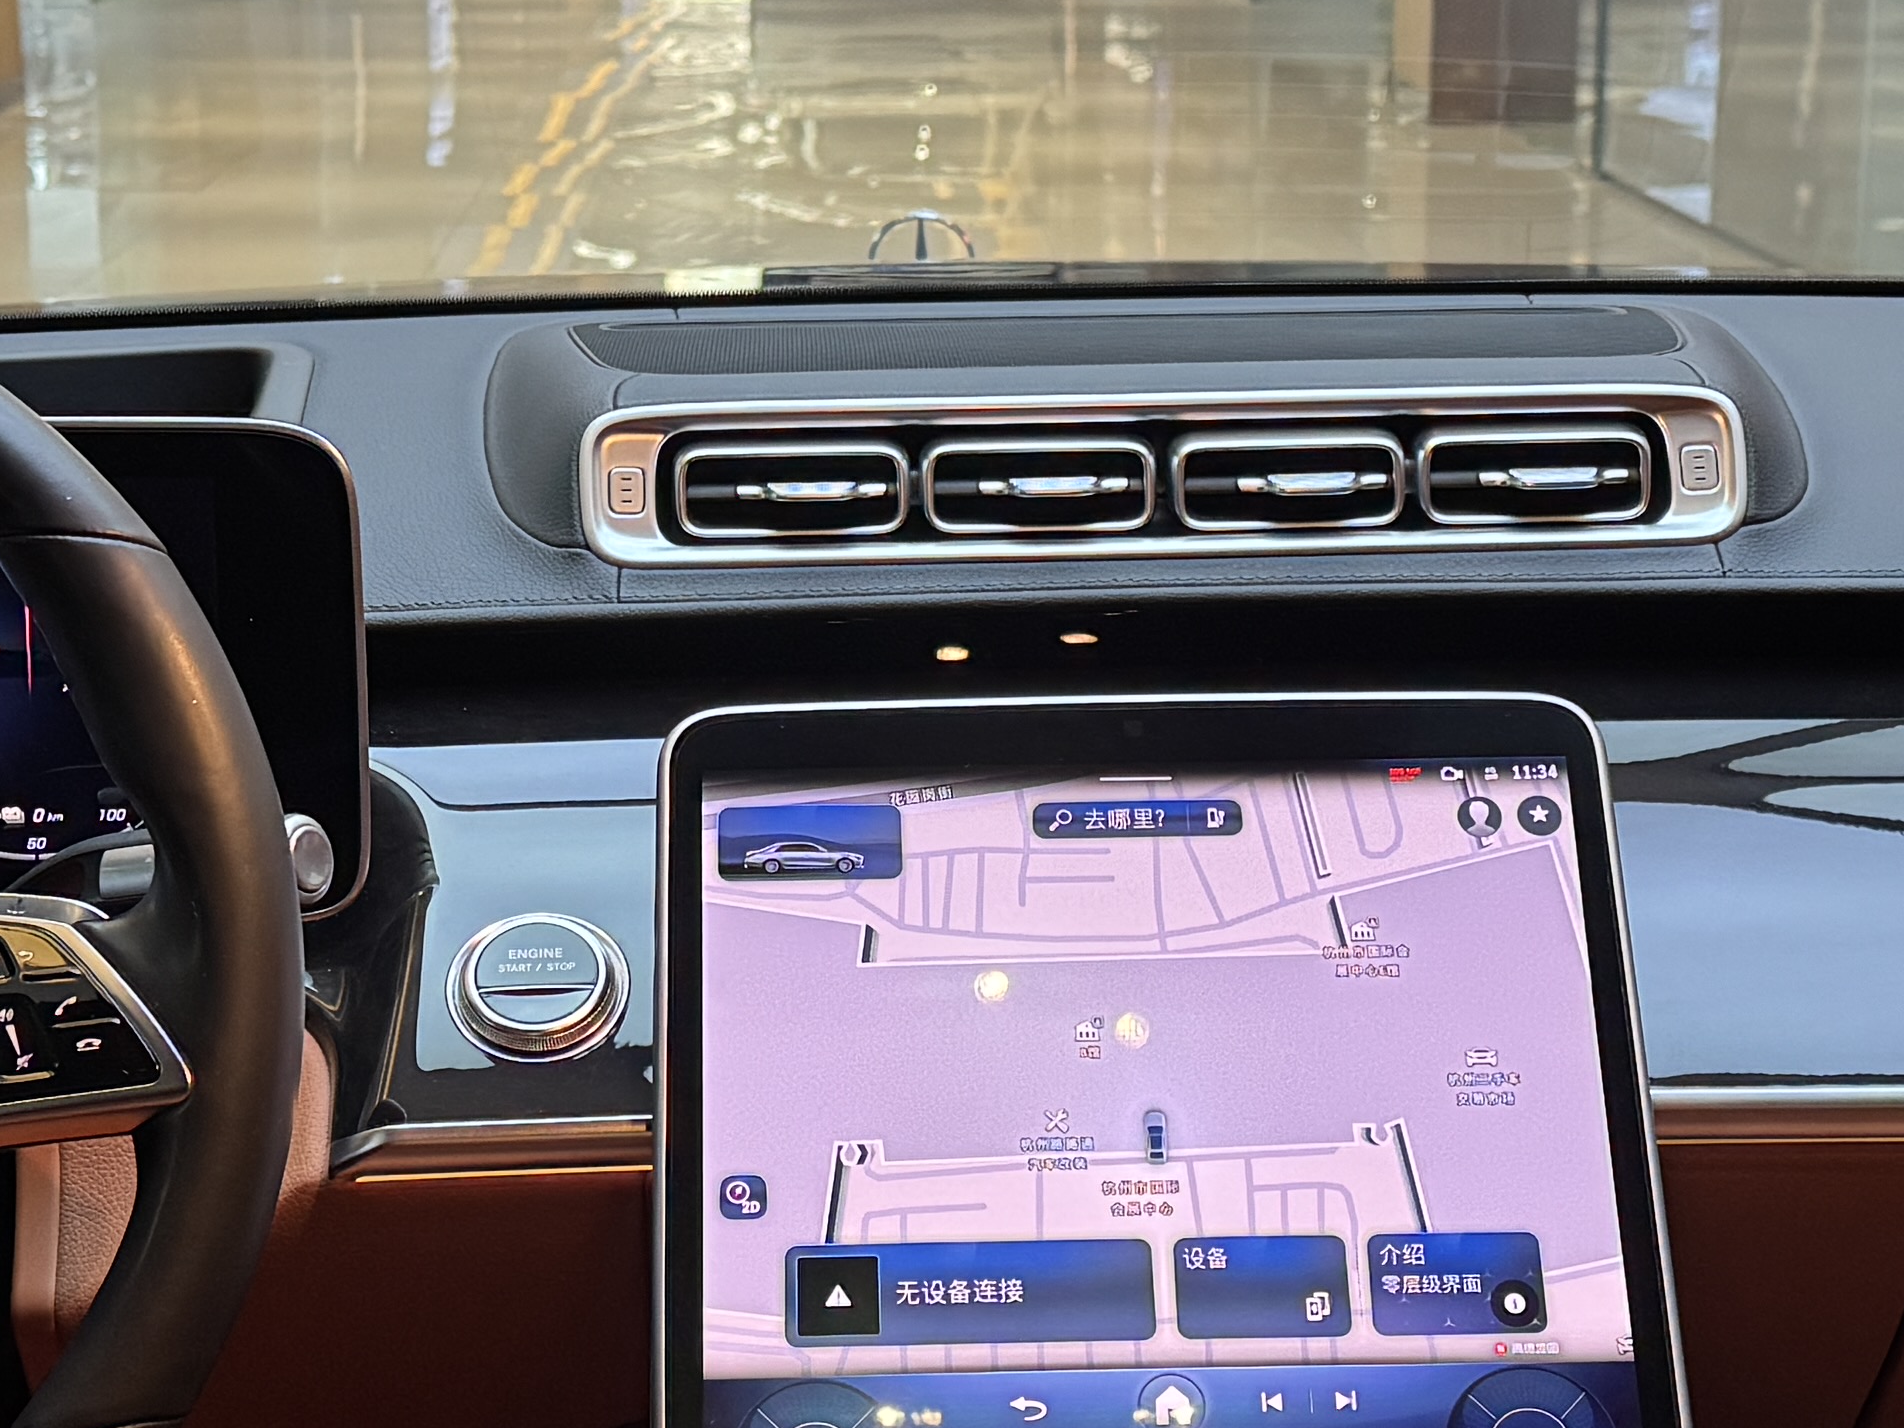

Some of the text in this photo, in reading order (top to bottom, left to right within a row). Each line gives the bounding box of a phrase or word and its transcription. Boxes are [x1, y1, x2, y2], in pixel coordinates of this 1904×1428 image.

[1512, 764, 1558, 780] 11:34
[33, 808, 46, 822] 0
[99, 808, 127, 821] 100
[1084, 807, 1165, 830] 去哪里?
[508, 948, 563, 960] ENGINE
[498, 963, 532, 973] START
[546, 961, 576, 972] STOP
[741, 1200, 761, 1214] 2D
[1182, 1247, 1228, 1270] 设备
[1379, 1243, 1426, 1266] 介绍
[896, 1278, 1024, 1305] 无设备连接
[1381, 1274, 1483, 1295] 零层级界面
